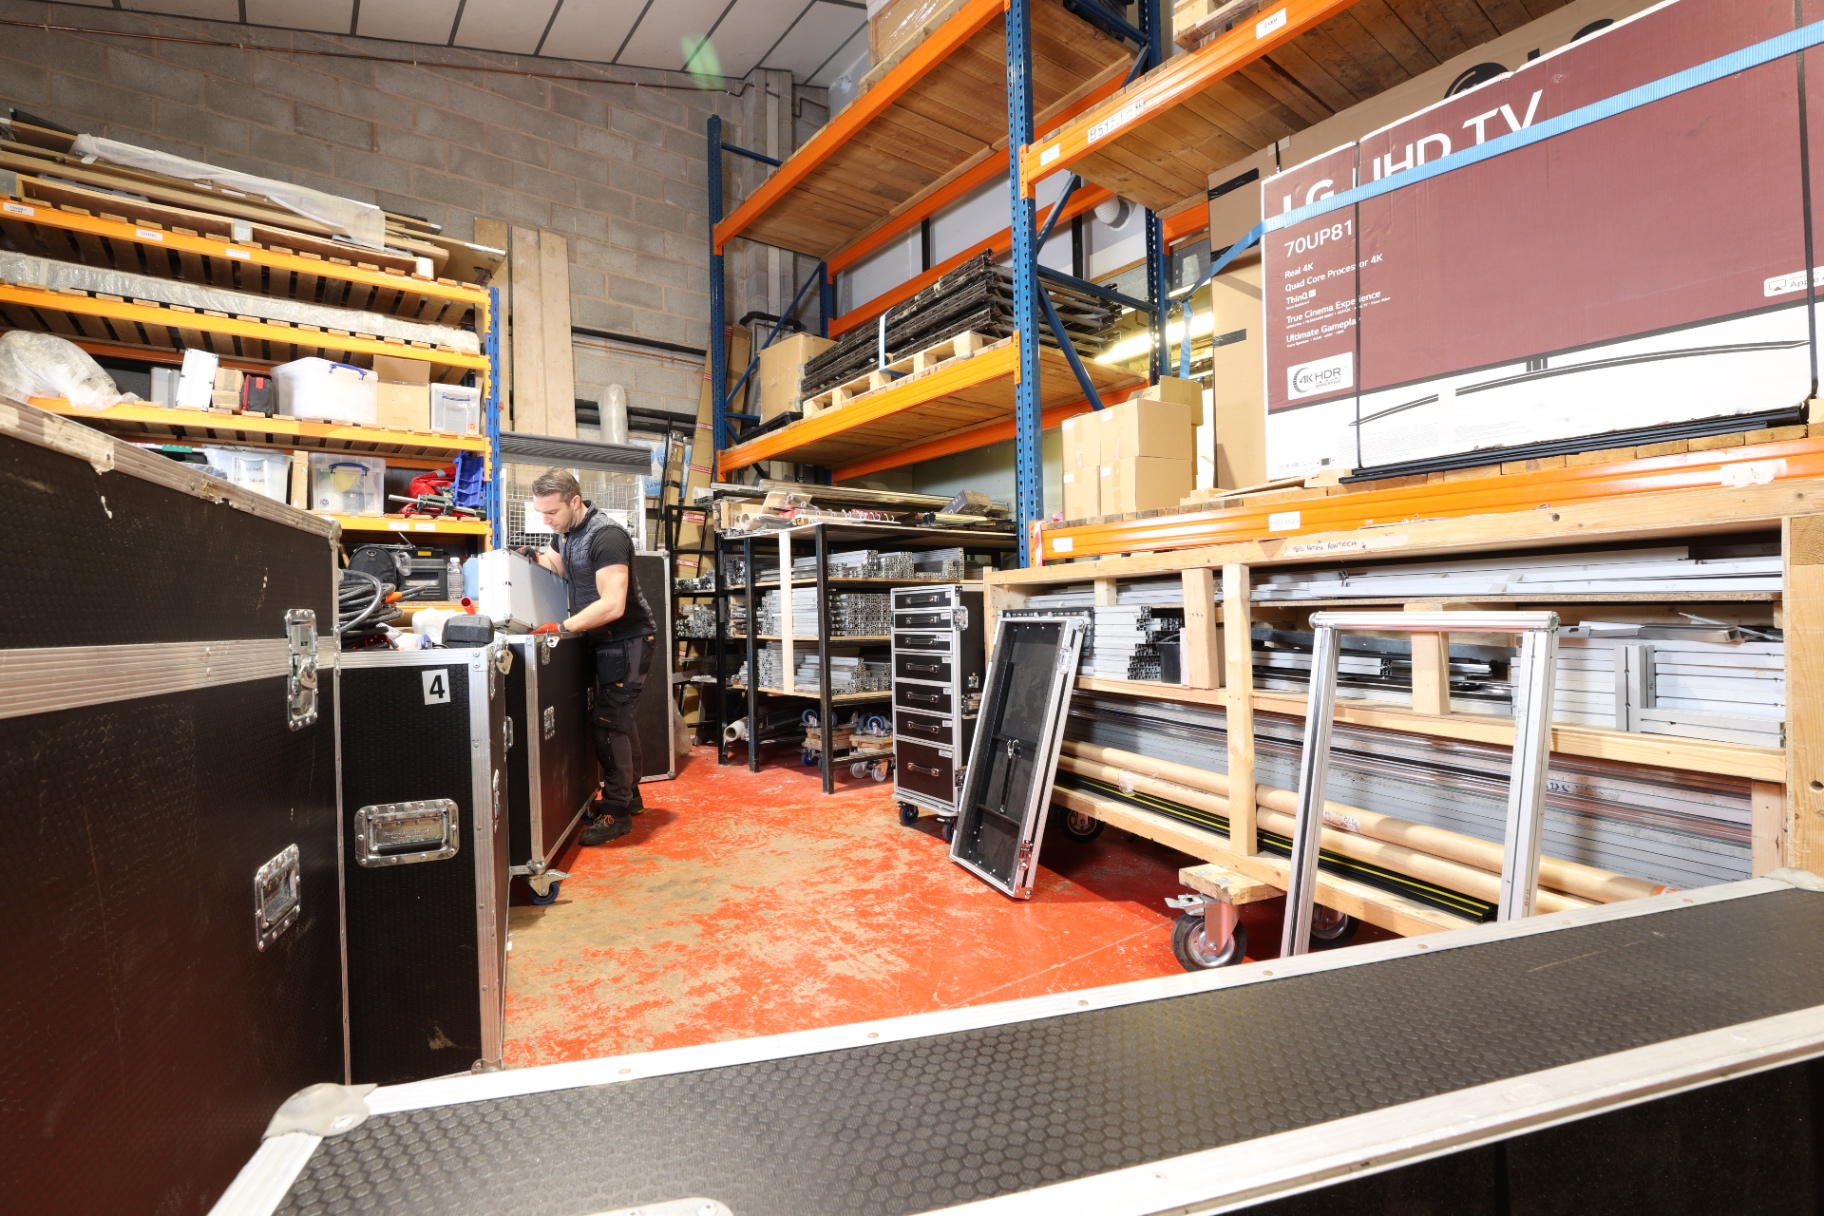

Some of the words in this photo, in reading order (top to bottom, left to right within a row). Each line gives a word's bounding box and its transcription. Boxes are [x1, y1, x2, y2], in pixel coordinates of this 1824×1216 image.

[1462, 89, 1543, 146] TV
[1284, 219, 1352, 258] 70UP81
[1285, 267, 1301, 279] Real
[1302, 262, 1314, 272] 4K
[1285, 280, 1305, 292] Quad
[1307, 273, 1326, 285] Core
[1327, 259, 1369, 278] Procesor
[1370, 253, 1383, 264] 4K
[1286, 291, 1308, 305] ThinQ
[1286, 314, 1303, 324] True
[1304, 305, 1334, 319] Cinema
[1335, 291, 1381, 310] Expeience
[1286, 328, 1320, 343] Ultimate
[1321, 317, 1362, 333] Gamepla
[1299, 373, 1314, 384] 4K
[1315, 367, 1341, 381] HDR
[429, 674, 446, 699] 4
